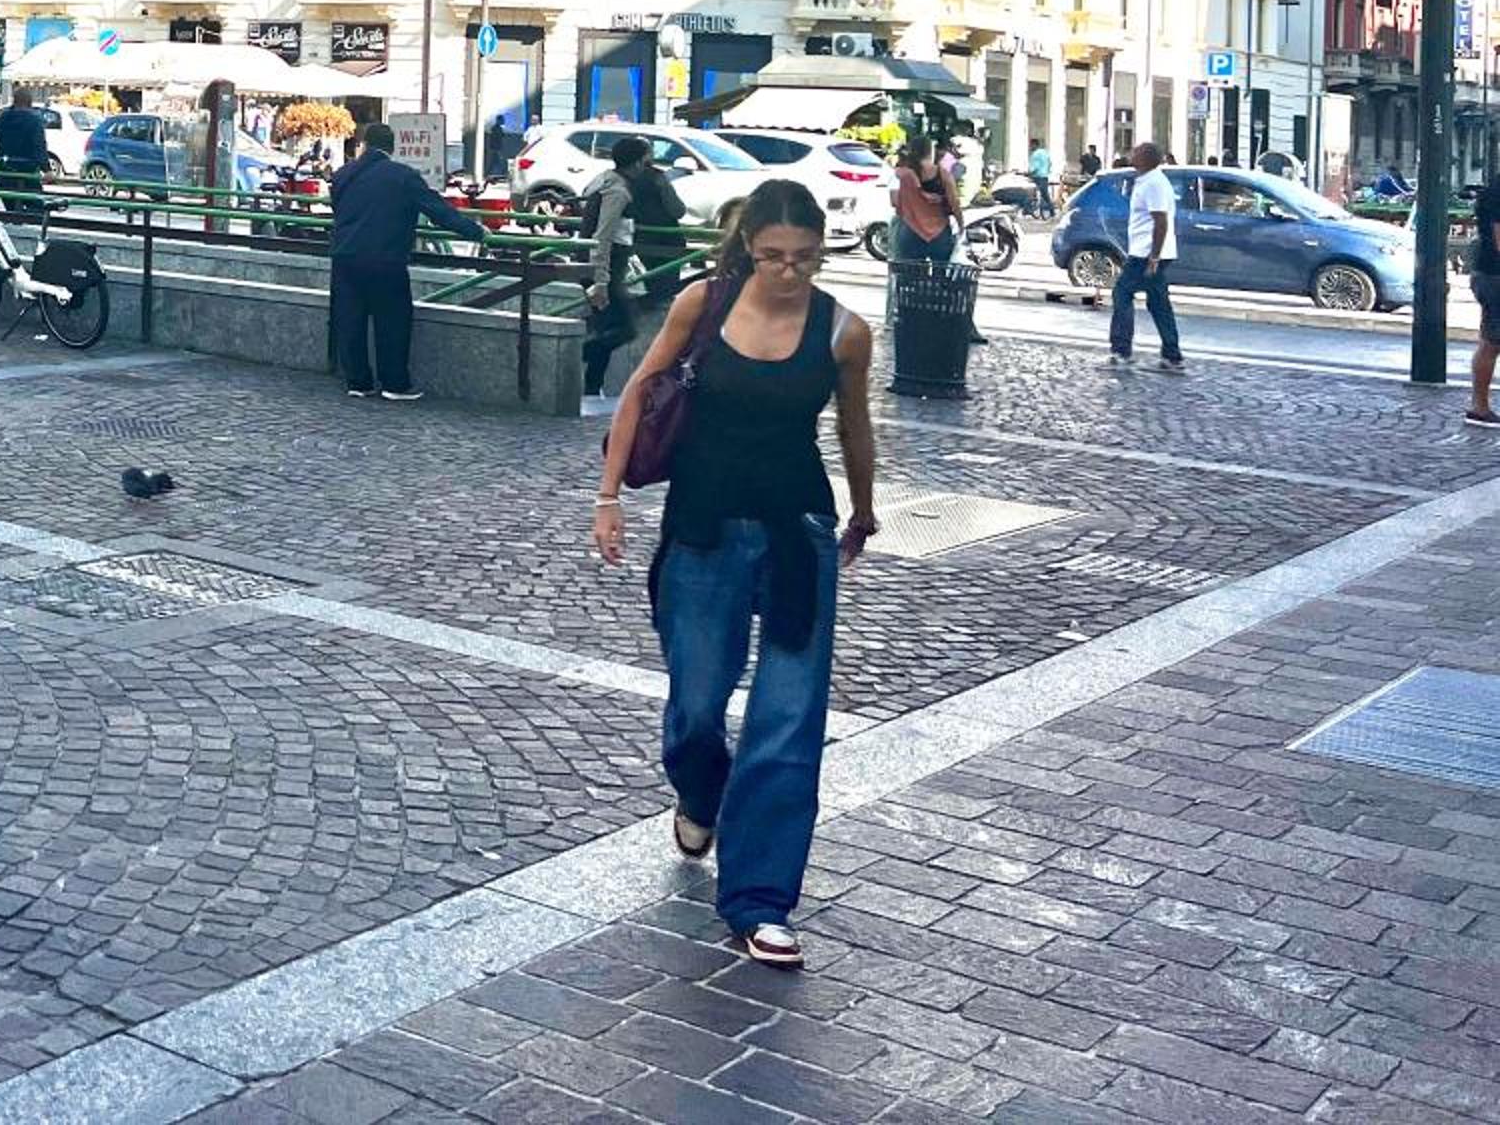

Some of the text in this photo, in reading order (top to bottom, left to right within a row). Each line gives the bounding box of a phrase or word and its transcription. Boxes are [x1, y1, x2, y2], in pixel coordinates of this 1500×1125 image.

[1212, 54, 1230, 74] P
[399, 130, 431, 144] Wi-Fi
[399, 146, 431, 157] area
